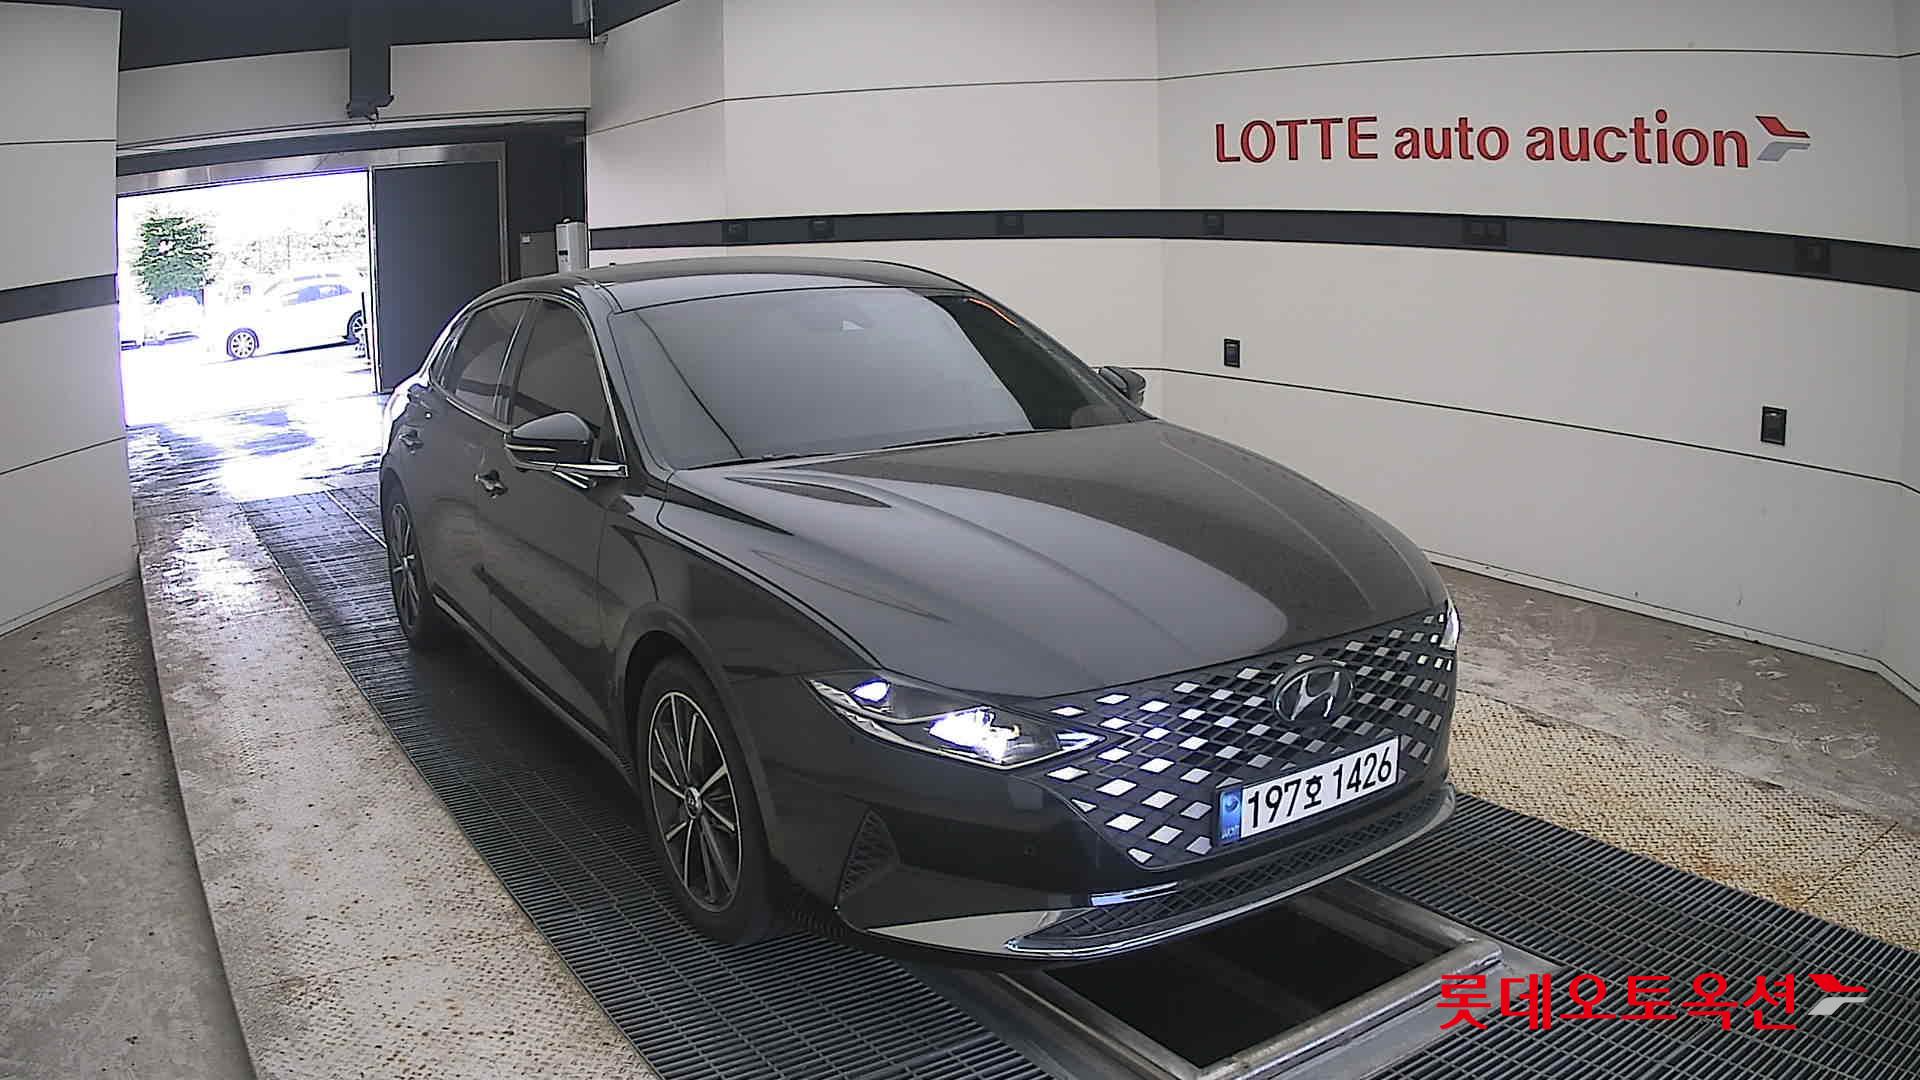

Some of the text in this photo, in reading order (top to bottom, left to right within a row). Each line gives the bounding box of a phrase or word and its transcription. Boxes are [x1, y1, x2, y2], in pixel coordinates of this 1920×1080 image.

[1215, 109, 1749, 168] LOTTE auto auction
[1247, 746, 1392, 829] 197호 1426
